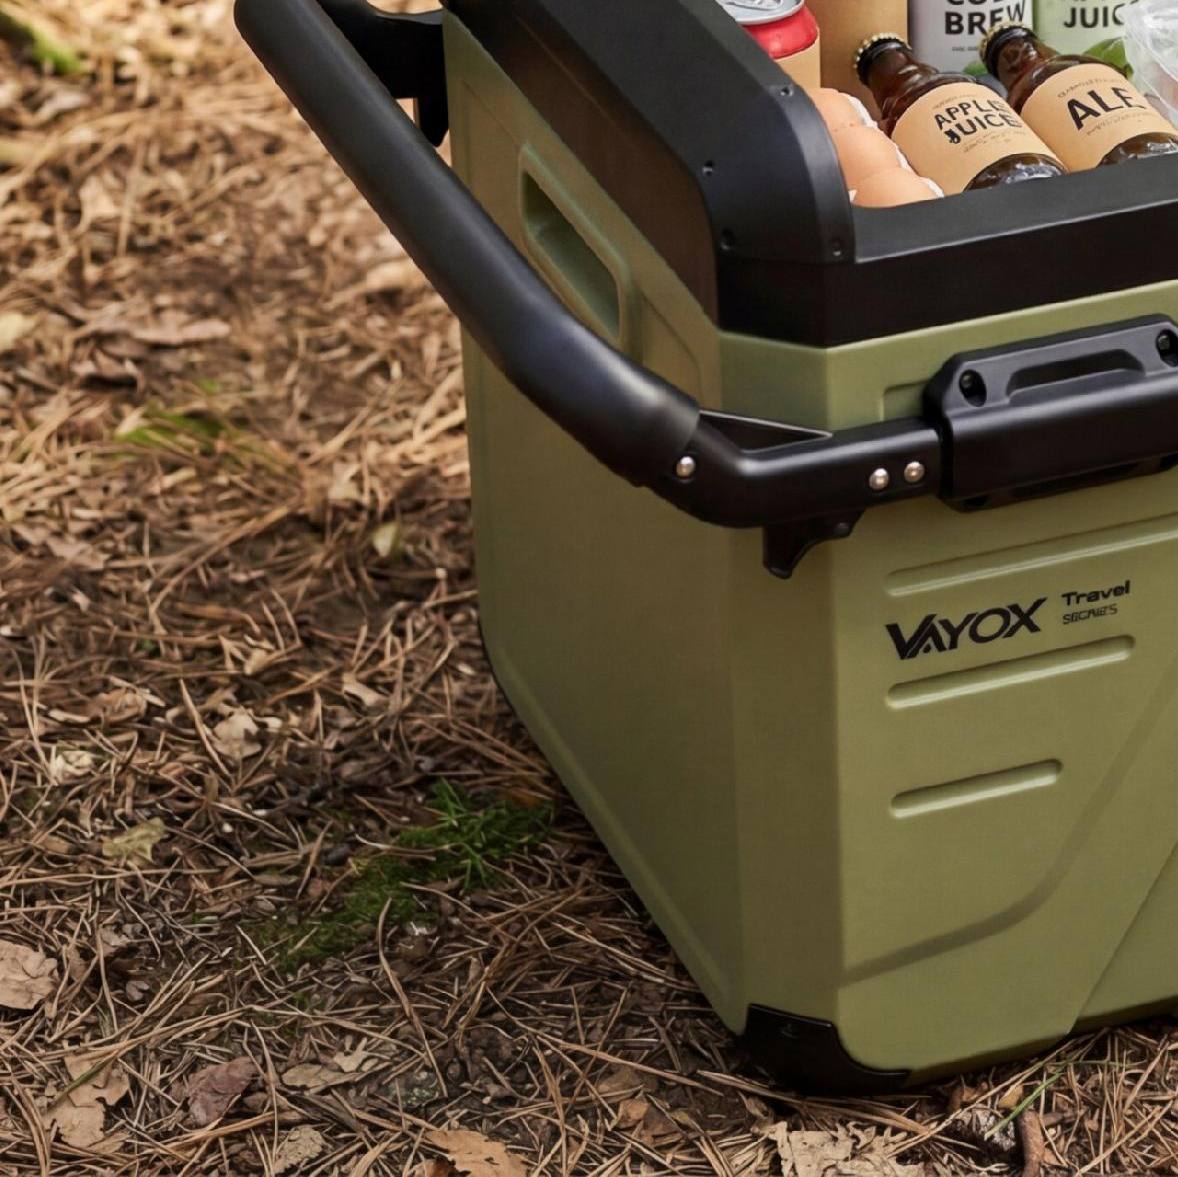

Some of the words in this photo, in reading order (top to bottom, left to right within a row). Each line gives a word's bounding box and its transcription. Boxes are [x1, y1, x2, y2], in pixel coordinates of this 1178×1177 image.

[934, 99, 1010, 131] APPLE
[1067, 86, 1147, 131] ALE
[944, 113, 1022, 144] JUICE
[1061, 579, 1131, 607] Travel
[885, 597, 1048, 661] VAYOX
